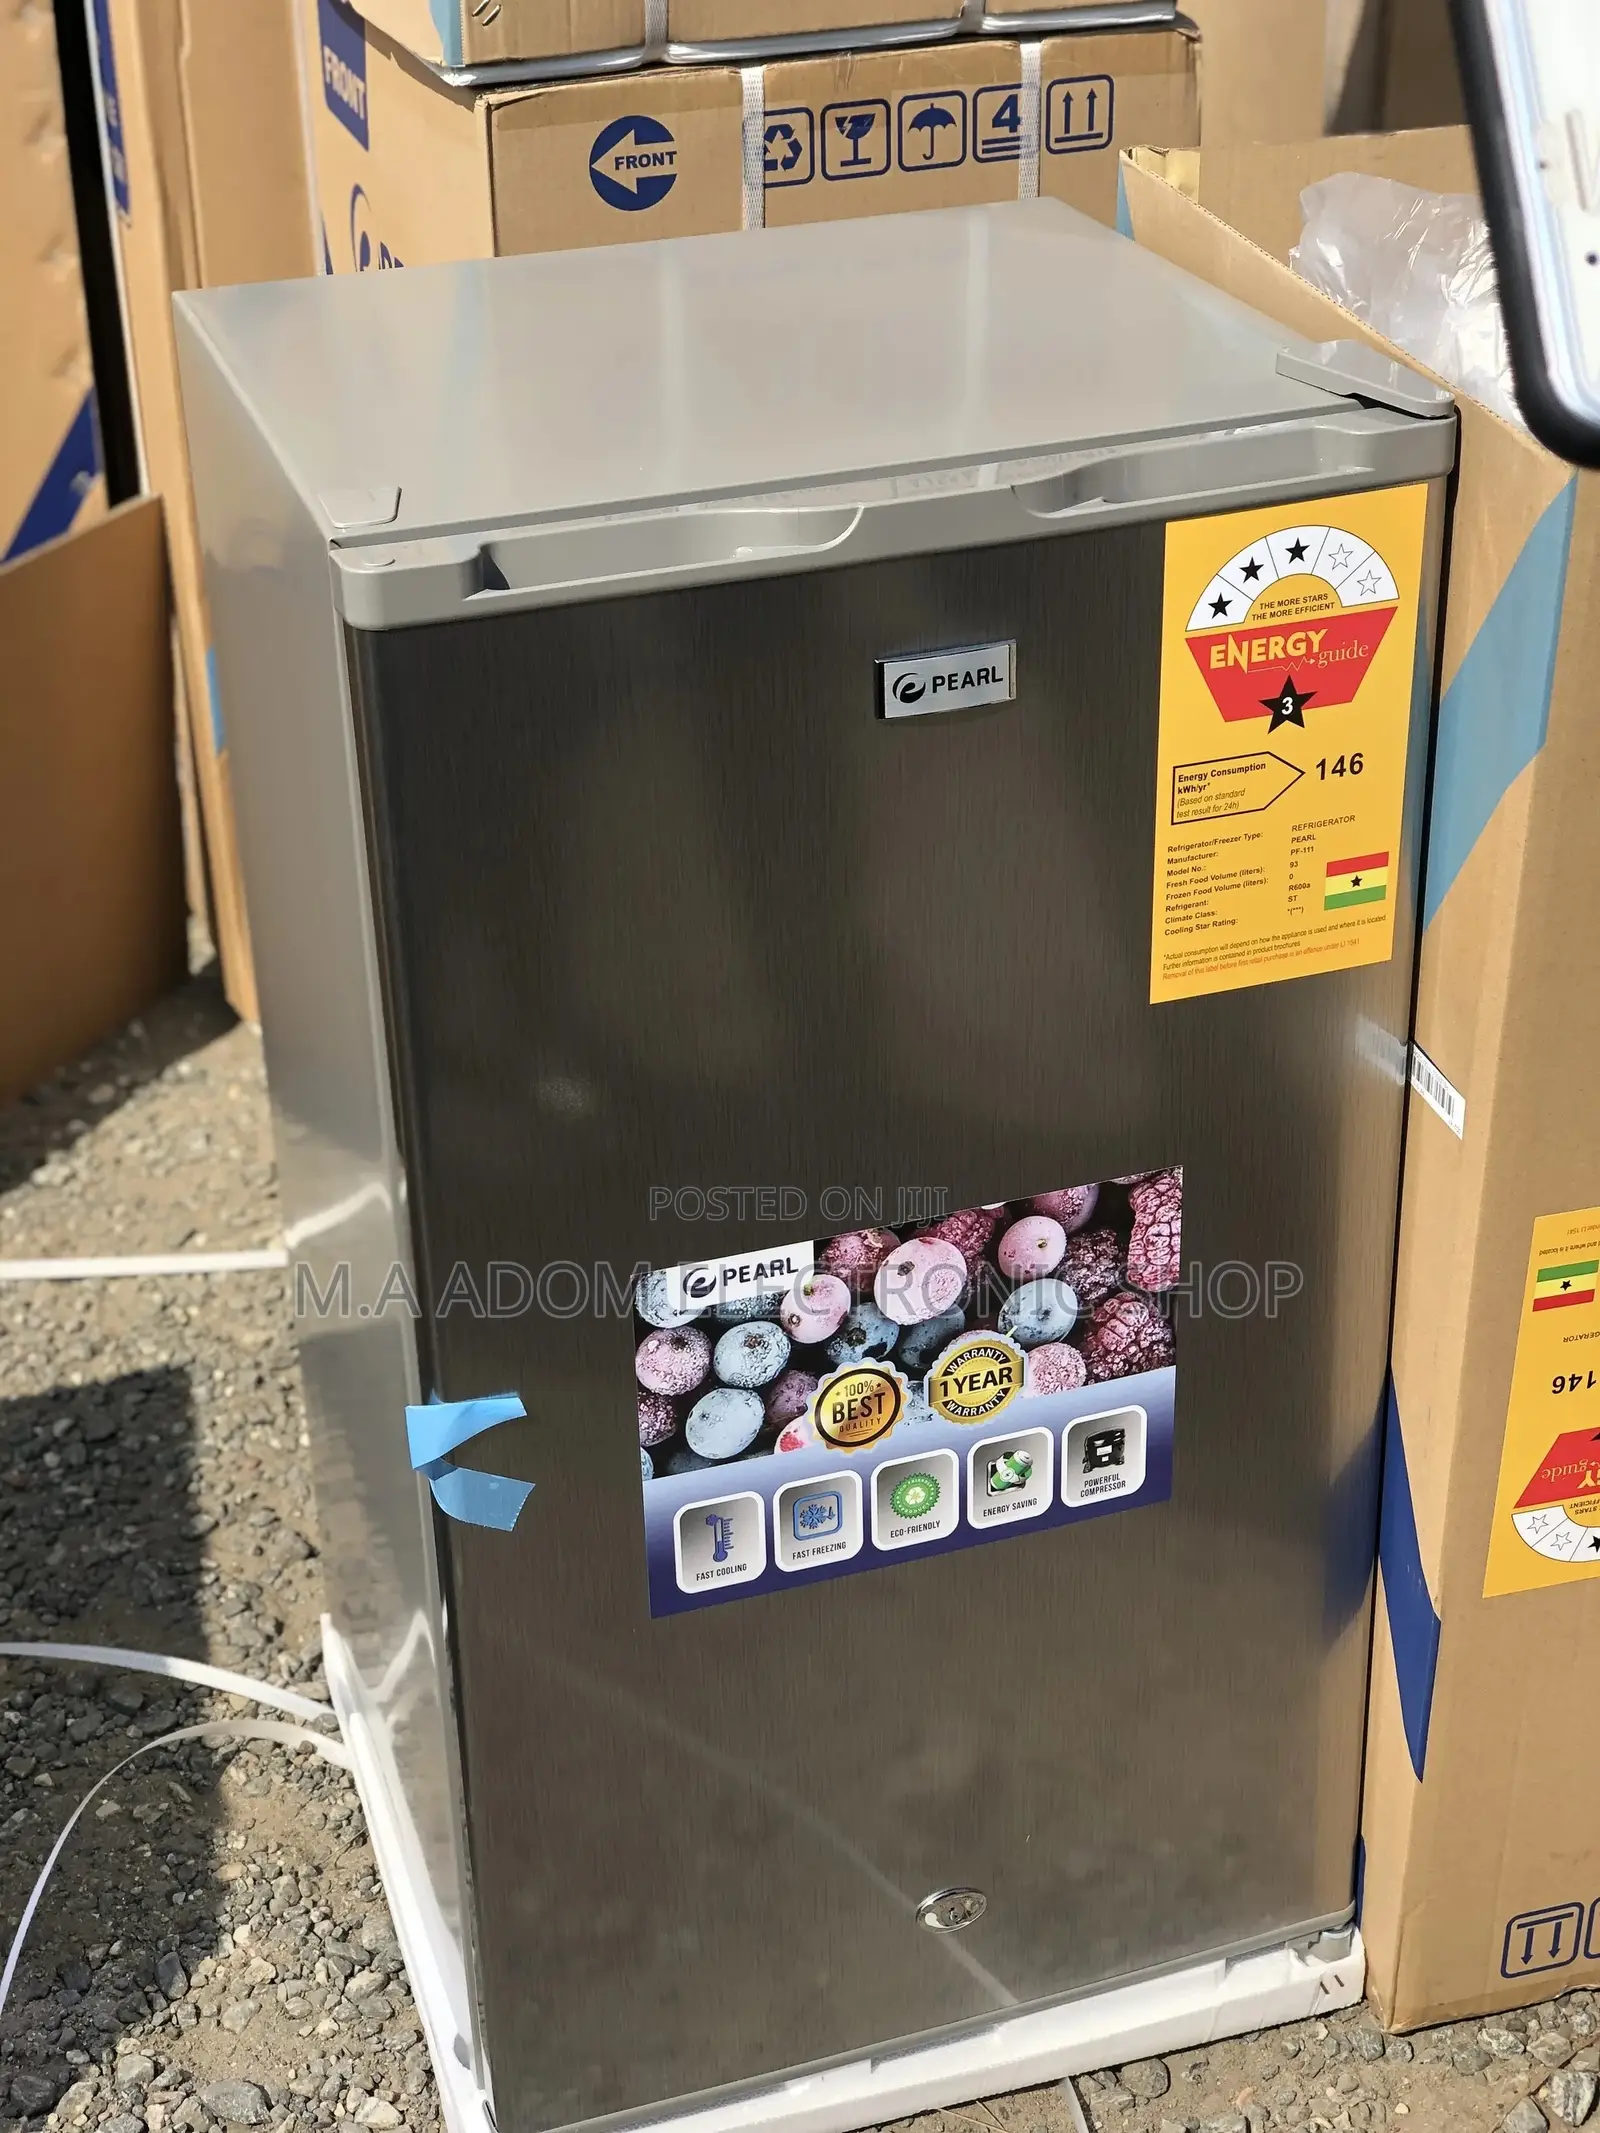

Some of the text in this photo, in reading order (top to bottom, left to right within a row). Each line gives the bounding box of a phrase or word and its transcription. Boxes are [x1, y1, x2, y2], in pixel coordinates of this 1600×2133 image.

[323, 45, 365, 119] FRONT
[992, 94, 1021, 133] 4
[615, 150, 677, 171] FRONT
[1260, 593, 1328, 610] THE MORE STARS
[1252, 602, 1335, 621] THE MORE EFFICIENT
[1210, 628, 1368, 674] ENERGY guide
[932, 666, 1003, 693] PEARL
[1282, 697, 1293, 715] 3
[1178, 763, 1266, 783] Energy Consumption
[1315, 752, 1364, 781] 146
[1177, 795, 1202, 808] (Based
[1215, 788, 1246, 800] standard
[1177, 801, 1239, 818] test result for 24h)
[1291, 815, 1356, 832] REFRIGERATOR
[1167, 832, 1263, 853] Refrigerator/Freezer Type:
[1291, 834, 1316, 844] PEARL
[1167, 852, 1219, 865] Manufacturer:
[1290, 846, 1314, 855] PF-111
[1166, 866, 1265, 889] Fresh Food Volume (liters):
[1167, 867, 1189, 877] Model
[1166, 877, 1268, 900] Frozen Food Volume (liters):
[1289, 882, 1311, 891] R600a
[1165, 900, 1209, 912] Refrigerant:
[1165, 910, 1217, 924] Climate Class:
[1165, 918, 1238, 936] Cooling Star Rating:
[1184, 946, 1219, 957] consumption
[1229, 941, 1249, 949] depend
[1281, 930, 1307, 940] appliance
[1314, 925, 1327, 933] used
[1340, 921, 1355, 929] where
[1367, 914, 1386, 924] located
[1163, 962, 1181, 970] Further
[1182, 957, 1212, 967] information
[1219, 950, 1245, 960] contained
[1253, 945, 1273, 955] product
[1274, 940, 1300, 950] brochures
[1539, 1247, 1558, 1256] located
[722, 1256, 799, 1287] PEARL
[947, 1347, 1007, 1373] WARRANTY
[844, 1379, 874, 1398] 100%
[940, 1366, 1013, 1397] 1 YEAR
[1552, 1370, 1597, 1394] 146
[832, 1392, 886, 1424] BEST
[946, 1390, 1006, 1417] WARRANTY
[839, 1418, 882, 1433] QUALITY
[1084, 1473, 1121, 1488] POWERFUL
[1541, 1459, 1588, 1483] guide
[1080, 1480, 1126, 1498] COMPRESSOR
[983, 1498, 1037, 1517] ENERGY SAVING
[1569, 1499, 1600, 1509] FFICIENT
[1575, 1506, 1598, 1515] STARS
[890, 1520, 941, 1538] ECO-FRIENDLY
[792, 1541, 847, 1560] FAST FREEZING
[696, 1563, 747, 1581] FAST COOLING
